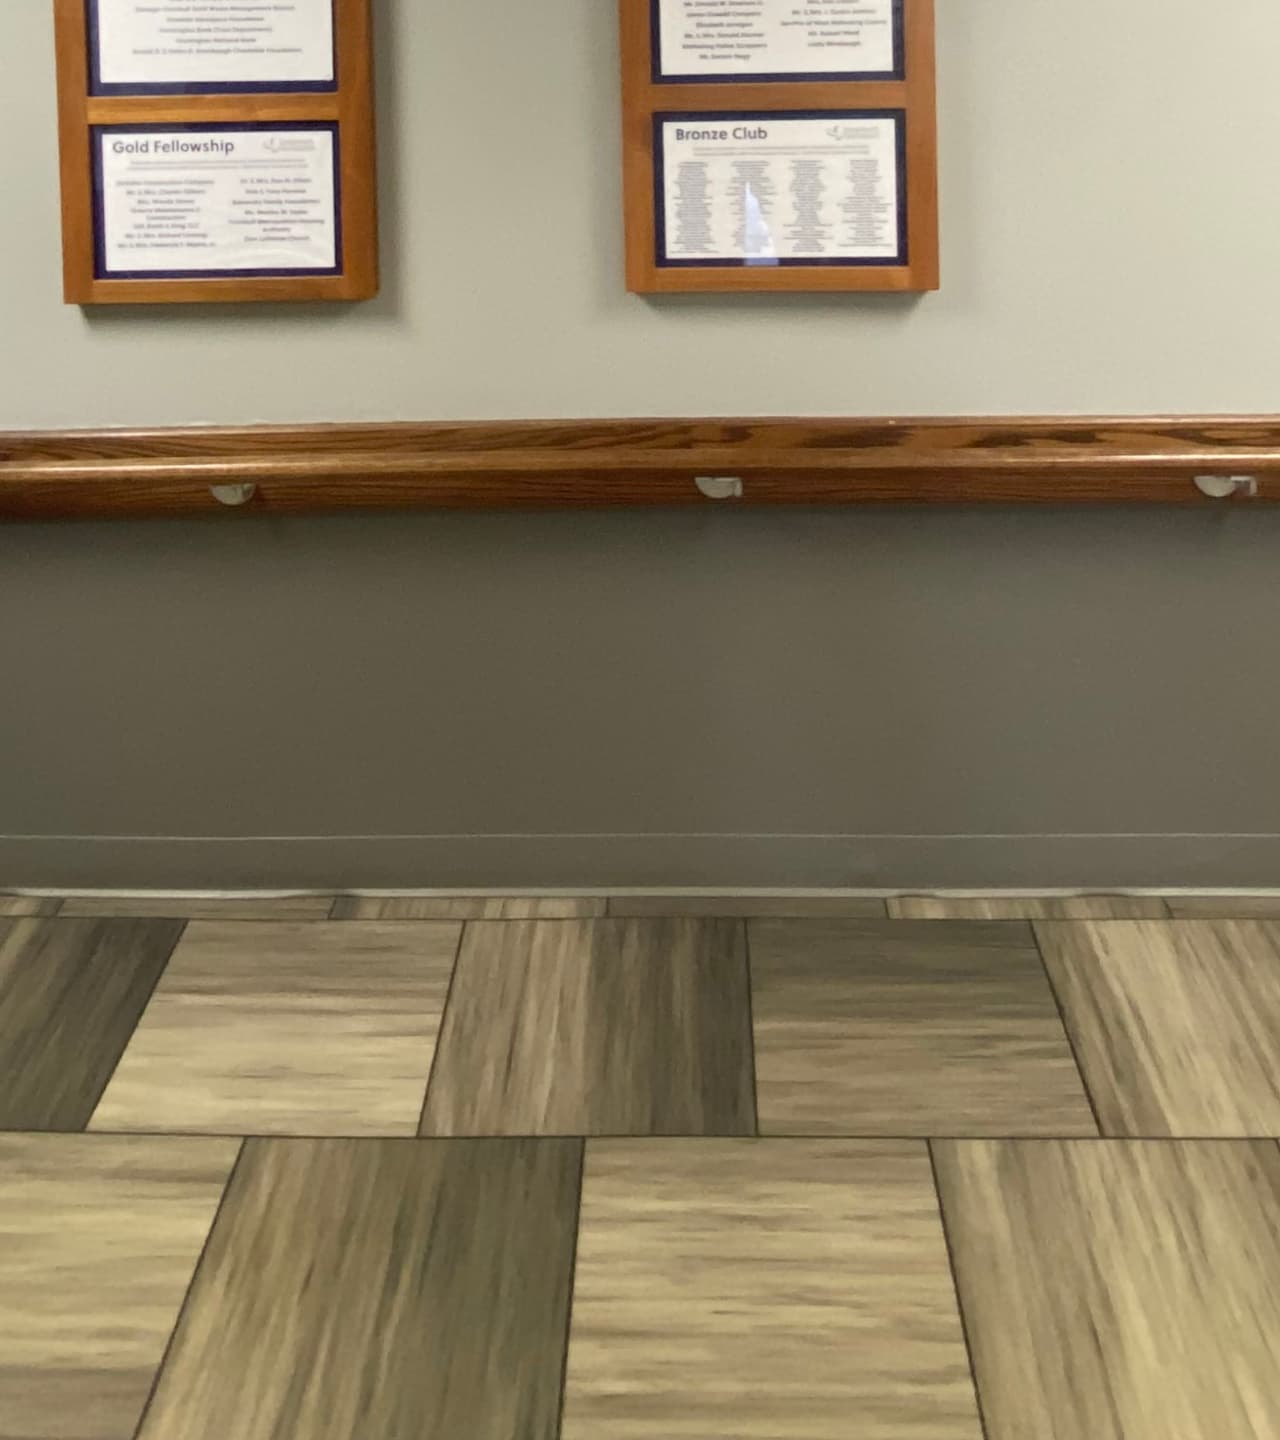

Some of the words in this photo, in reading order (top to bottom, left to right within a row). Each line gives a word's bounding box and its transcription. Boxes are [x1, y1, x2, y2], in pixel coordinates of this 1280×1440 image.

[675, 128, 728, 141] Bronze
[732, 127, 768, 140] Club
[112, 140, 149, 154] Gold
[154, 139, 235, 156] Fellowship
